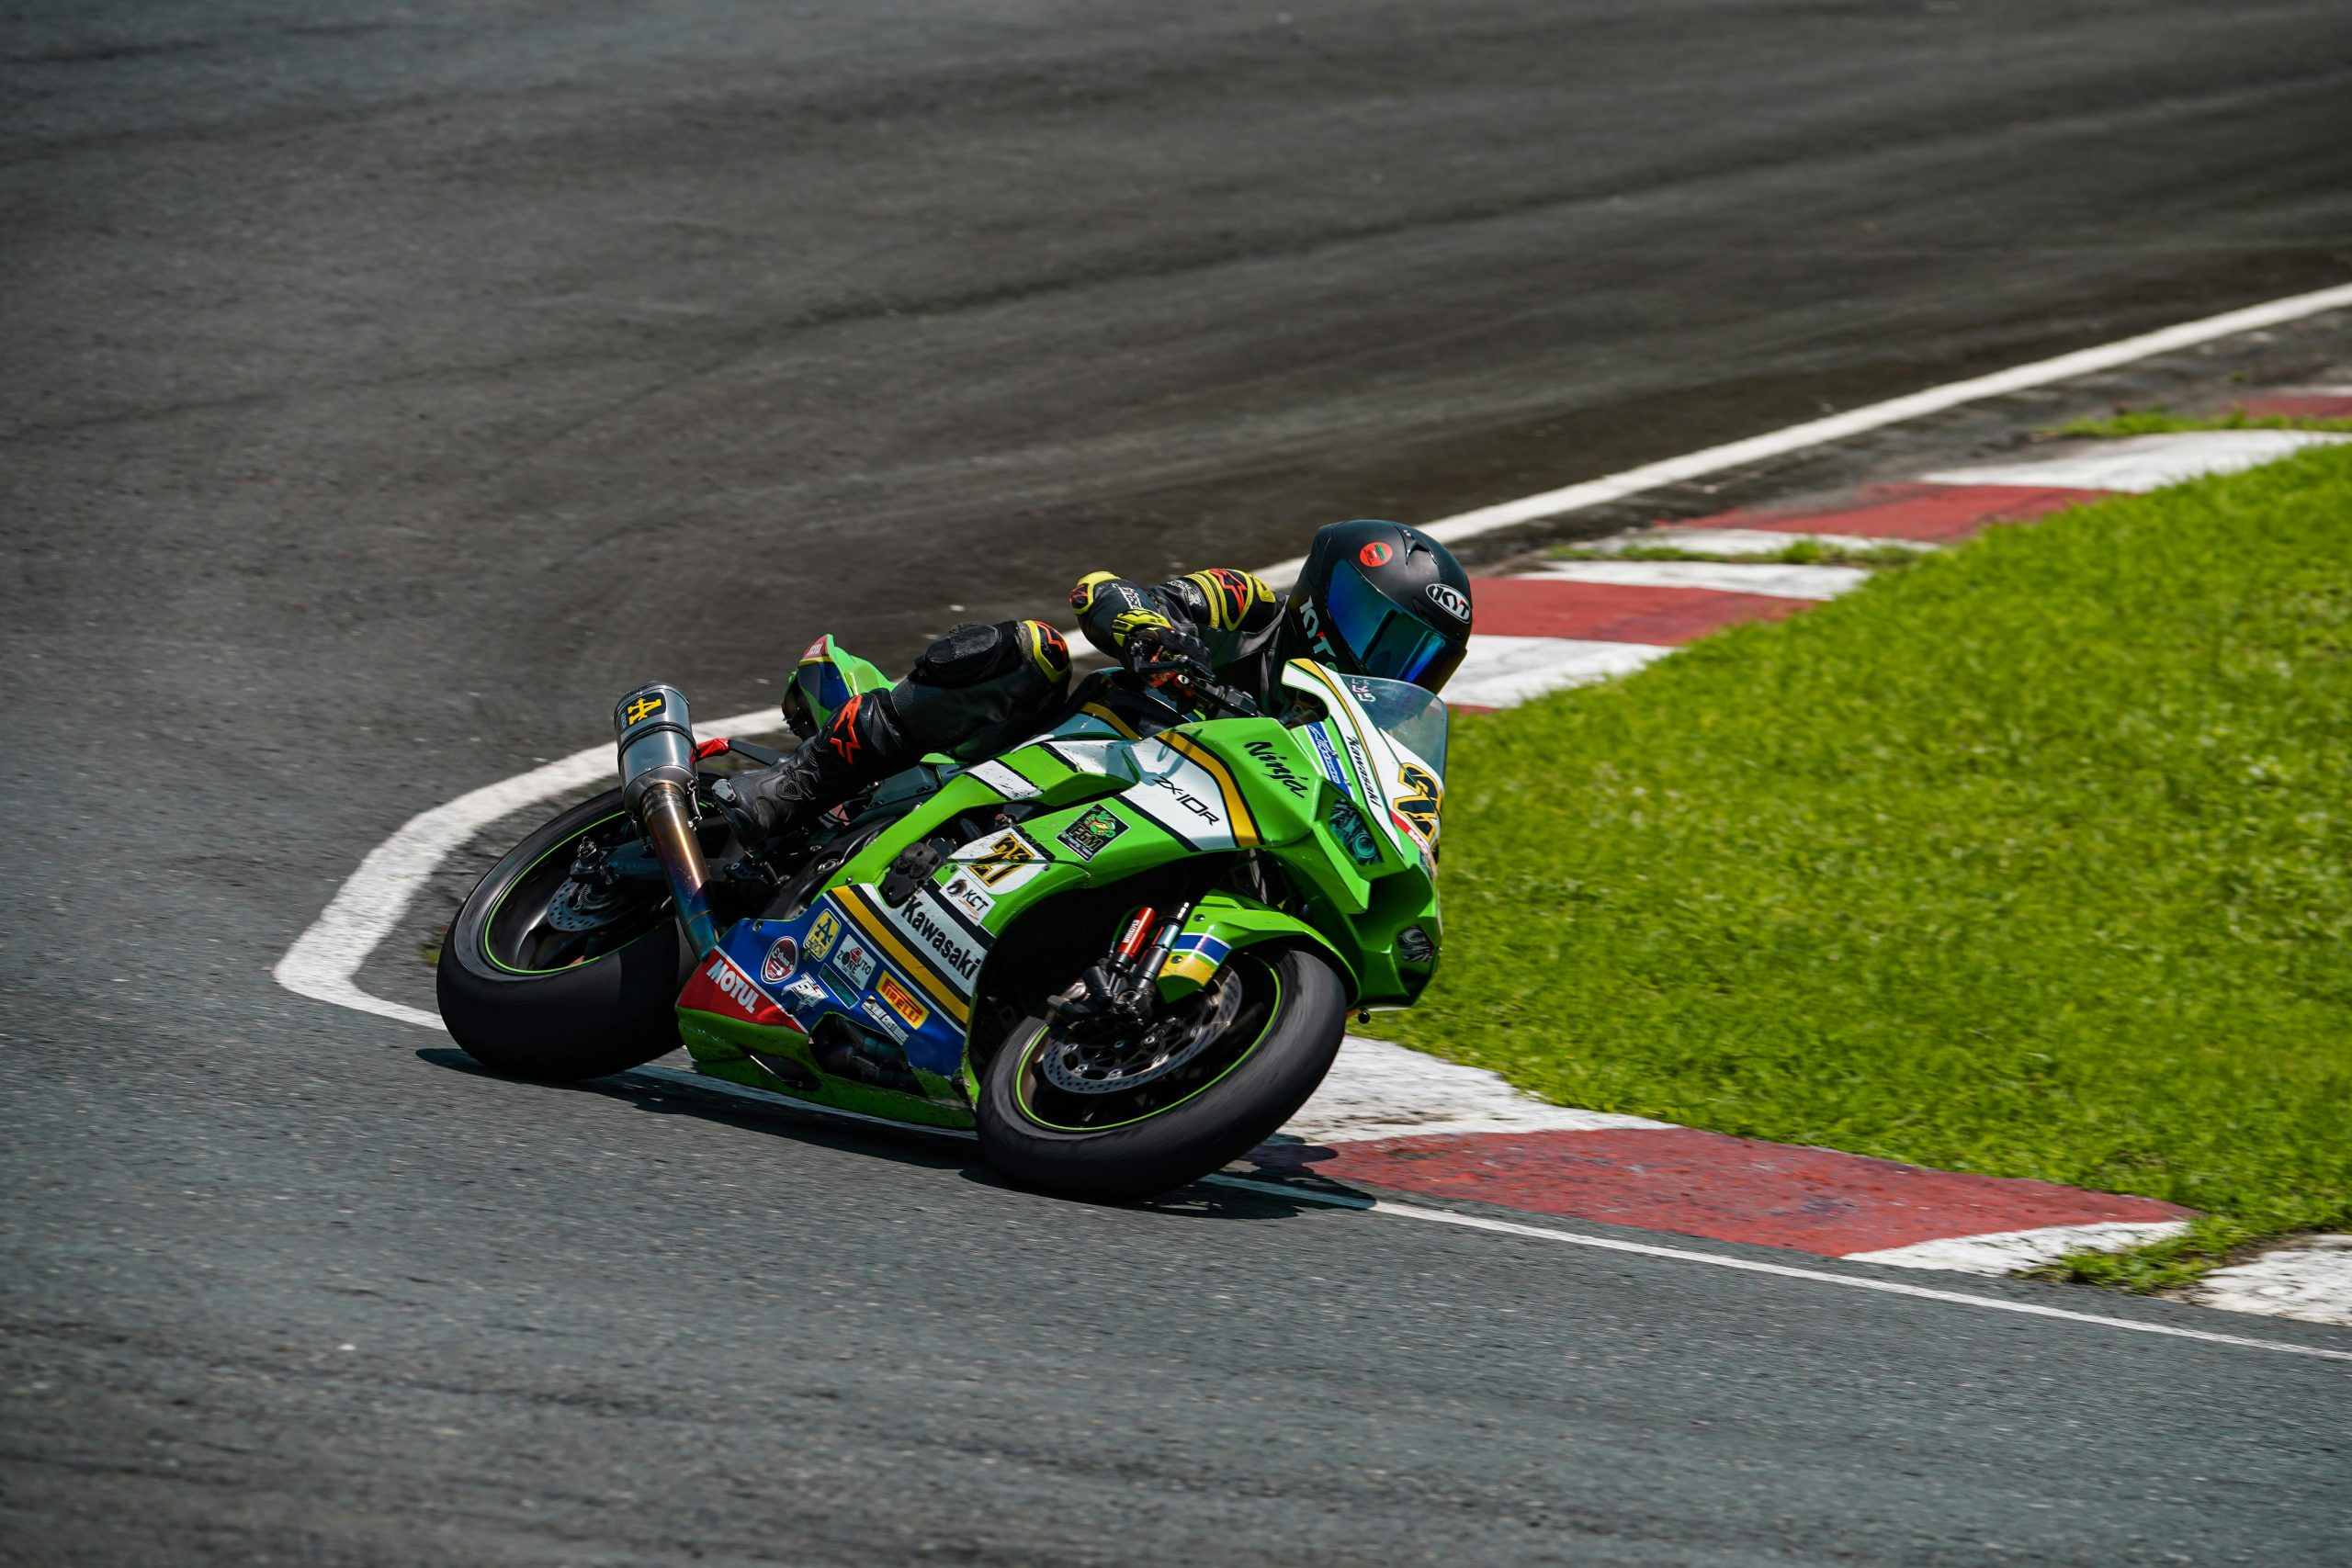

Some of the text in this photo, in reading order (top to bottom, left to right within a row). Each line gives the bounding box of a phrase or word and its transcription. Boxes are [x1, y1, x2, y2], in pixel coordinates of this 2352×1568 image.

[1299, 595, 1336, 658] KYT
[1432, 586, 1471, 619] KYT
[1243, 741, 1309, 799] Ninja
[1344, 736, 1382, 808] Kawasaki
[1152, 776, 1221, 826] ZX-10R
[967, 833, 1035, 888] 27
[900, 897, 982, 981] Kawasaki
[707, 959, 760, 1014] MOTUL
[881, 977, 924, 1023] PIRELLI
